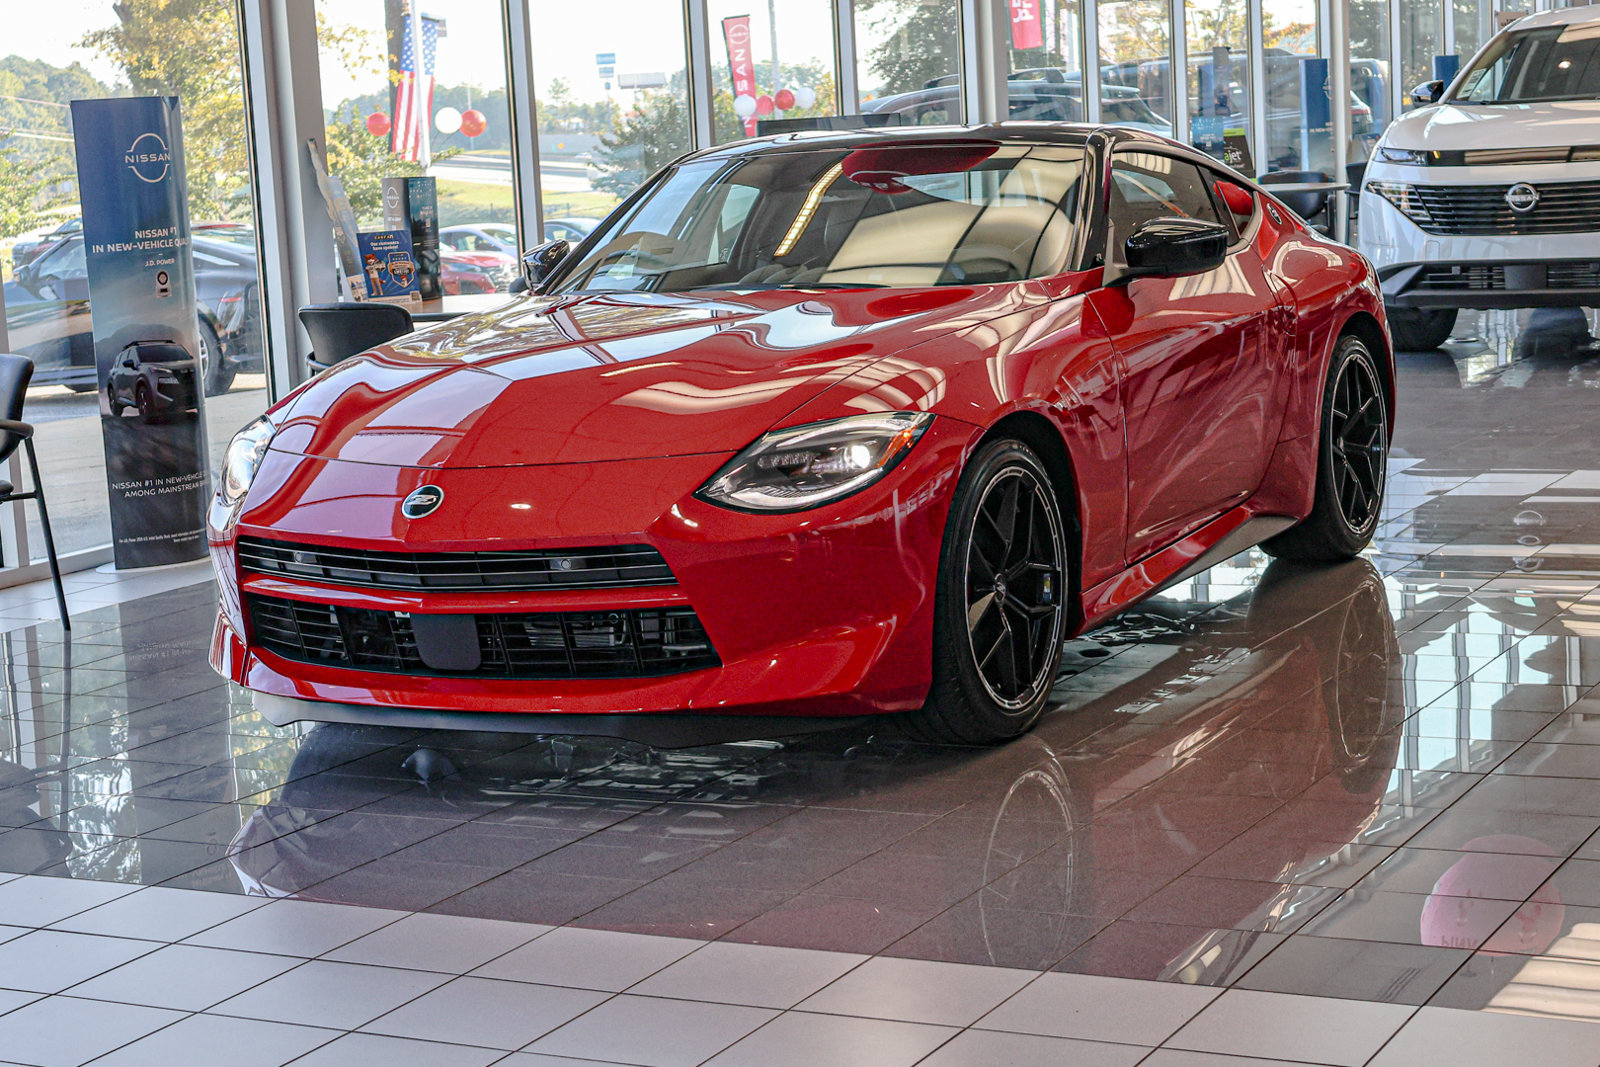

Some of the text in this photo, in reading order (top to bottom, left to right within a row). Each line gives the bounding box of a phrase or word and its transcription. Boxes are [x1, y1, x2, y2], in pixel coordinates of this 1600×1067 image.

[735, 49, 752, 128] NSAN
[125, 152, 171, 164] NISSAN
[134, 226, 177, 239] NISSAN #1
[92, 244, 105, 253] IN
[107, 238, 174, 253] NEW-VEHICLE
[112, 480, 142, 490] NISSAN
[155, 478, 164, 486] IN
[124, 488, 156, 498] AMONG
